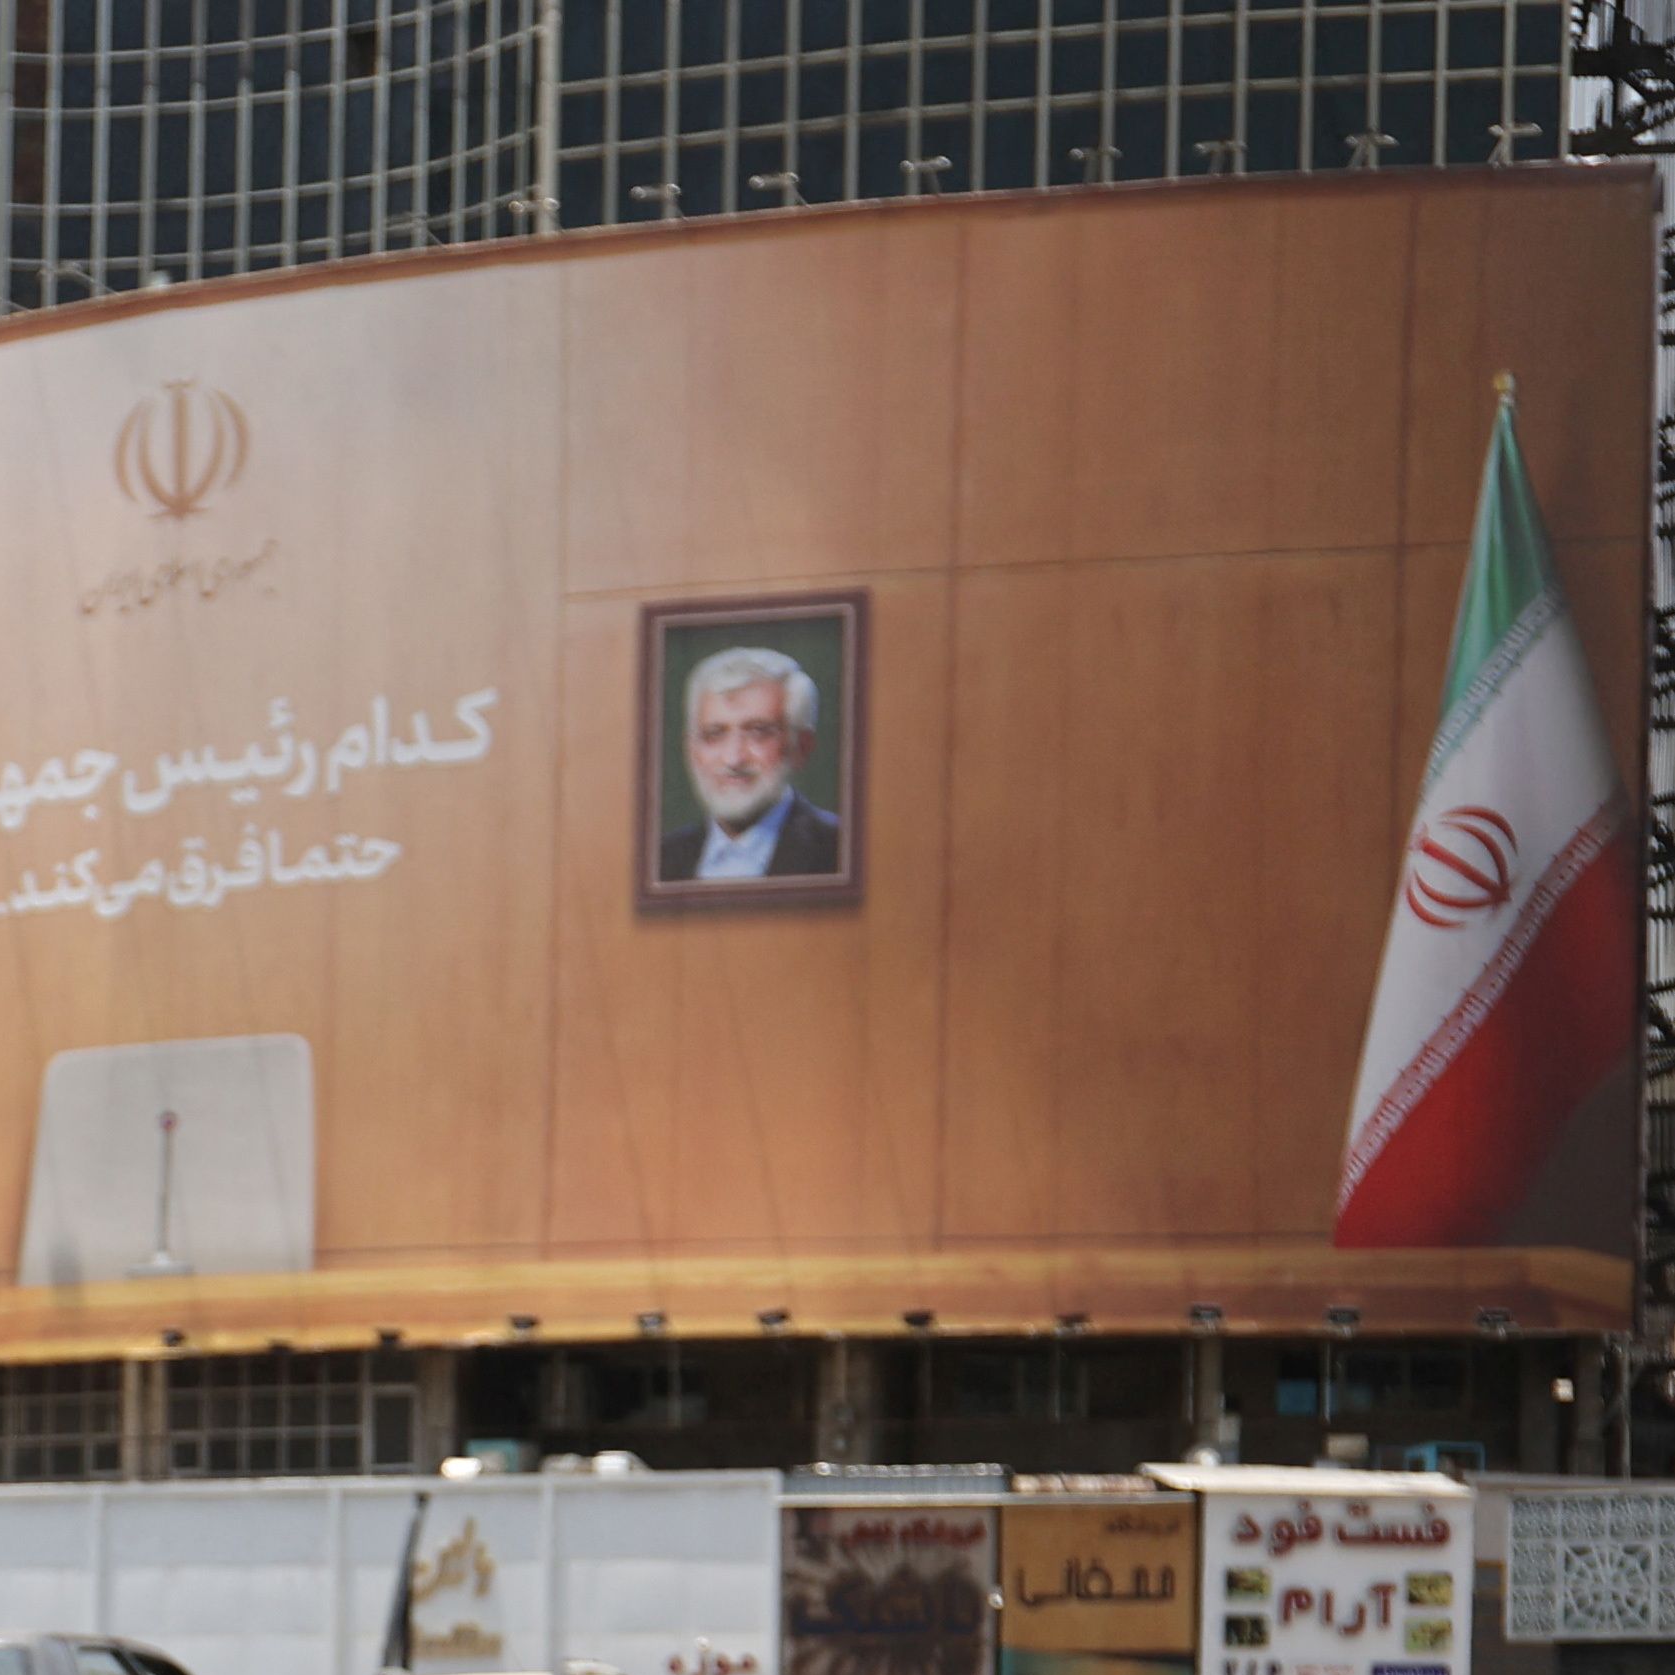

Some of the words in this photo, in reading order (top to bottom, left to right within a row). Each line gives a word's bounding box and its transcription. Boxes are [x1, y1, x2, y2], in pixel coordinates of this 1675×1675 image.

[121, 697, 319, 812] رئیس
[328, 687, 498, 792] کدام
[167, 822, 265, 907] فرق
[268, 827, 402, 883] حتما
[1234, 1500, 1324, 1556] فود
[1334, 1501, 1451, 1547] فست
[1280, 1582, 1397, 1636] آرام
